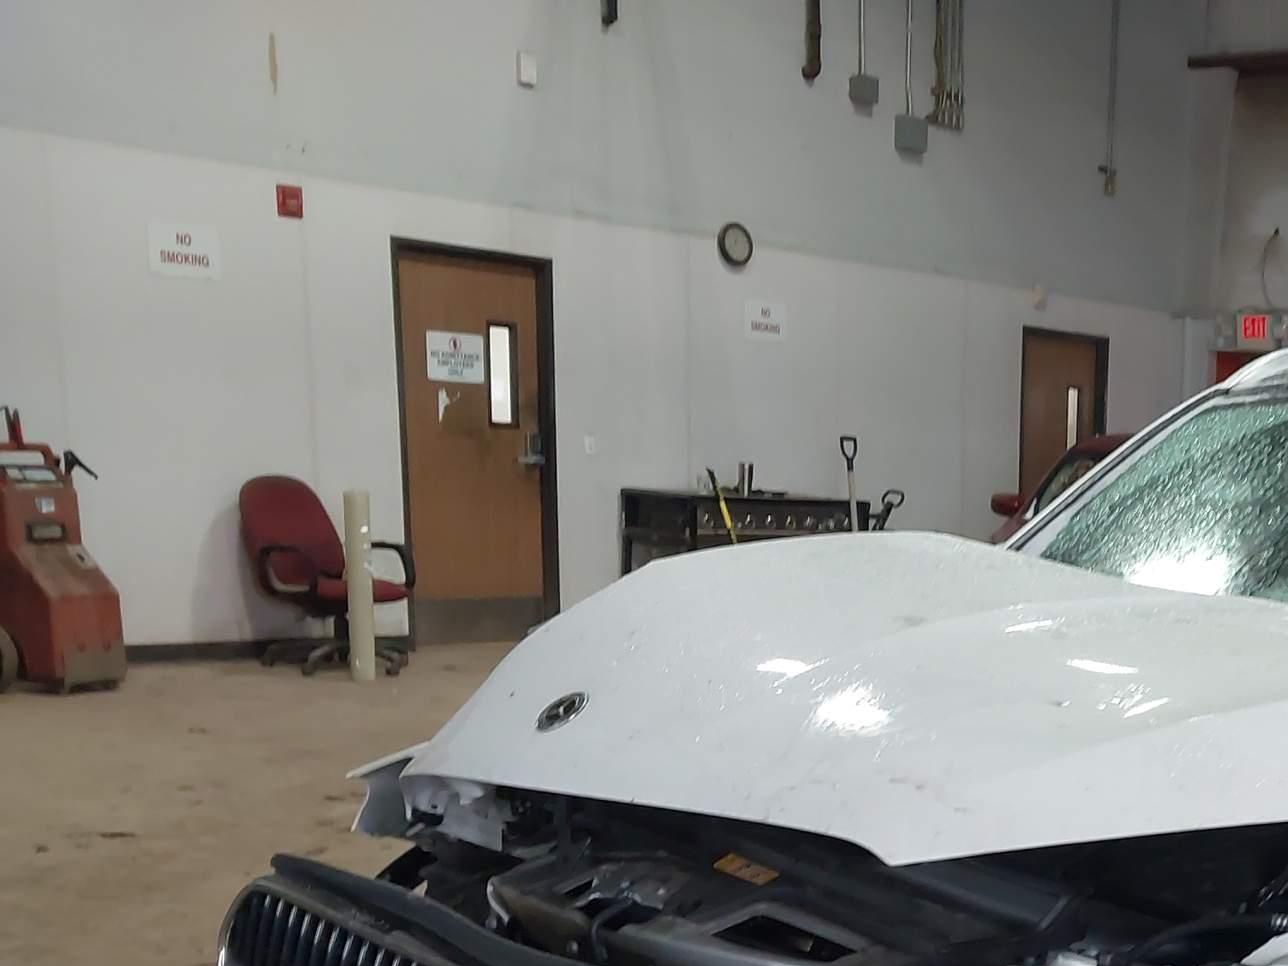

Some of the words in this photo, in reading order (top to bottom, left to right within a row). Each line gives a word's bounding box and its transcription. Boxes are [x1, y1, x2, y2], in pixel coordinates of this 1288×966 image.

[175, 232, 192, 247] NO
[159, 250, 210, 267] SMOKING
[1243, 315, 1266, 339] EXIT
